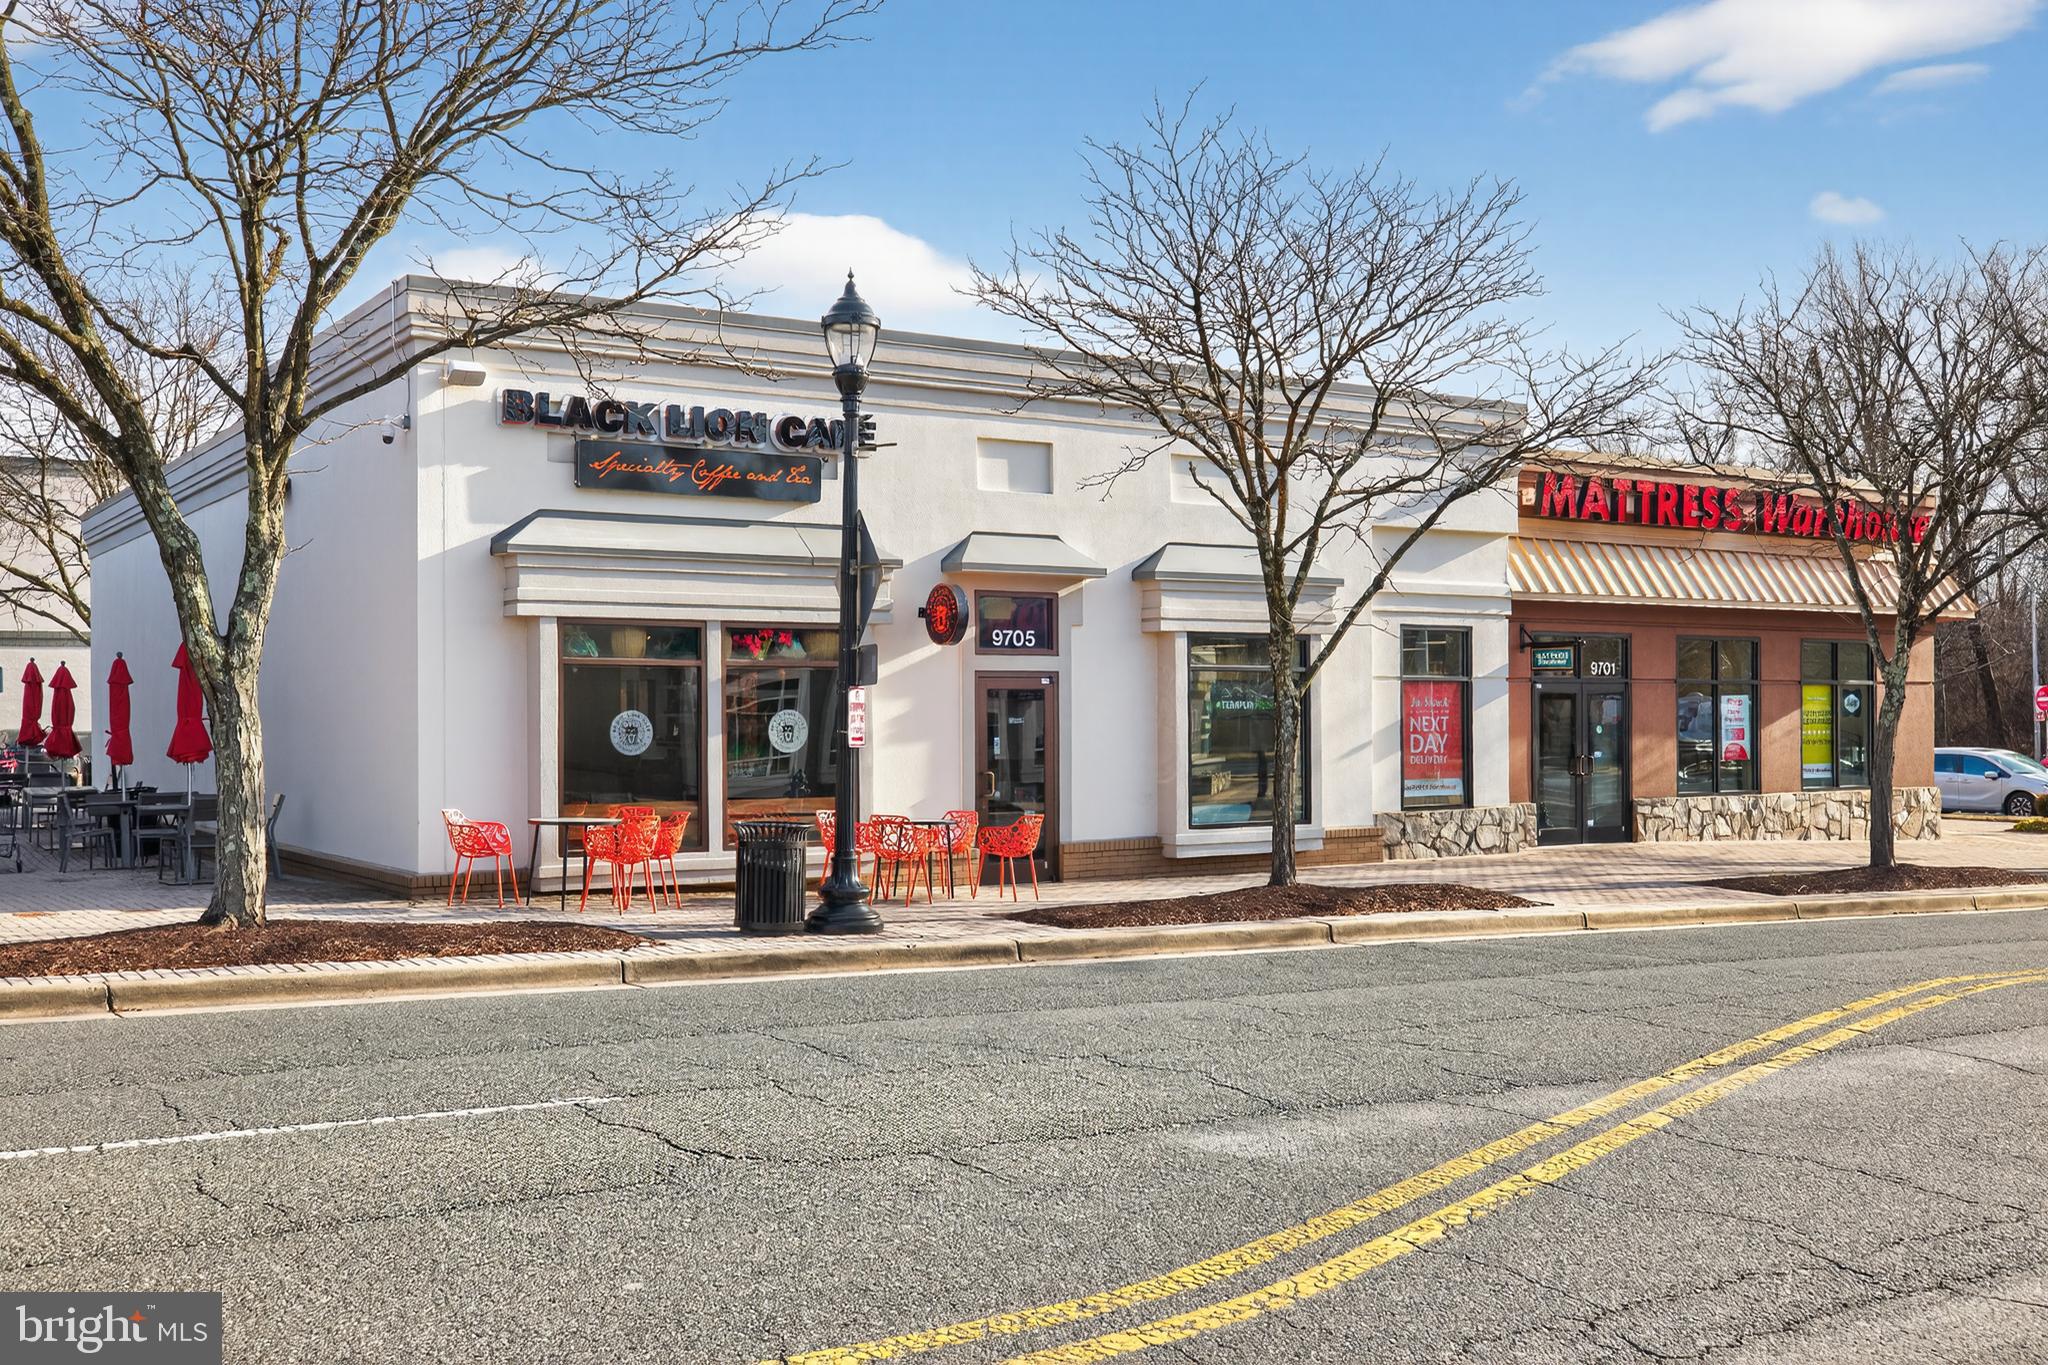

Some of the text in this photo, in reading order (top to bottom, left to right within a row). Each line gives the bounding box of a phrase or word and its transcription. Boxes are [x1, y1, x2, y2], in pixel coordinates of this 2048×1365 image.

[500, 388, 661, 438] BLACK
[662, 403, 769, 446] LION
[589, 450, 691, 483] Specialty
[690, 458, 742, 491] Coffee
[746, 469, 784, 483] and
[1538, 470, 1933, 544] MATTRESS Warehoue
[992, 629, 1036, 647] 9705
[1590, 661, 1616, 676] 9701
[1409, 716, 1450, 732] NEXT
[1409, 733, 1449, 754] DAY
